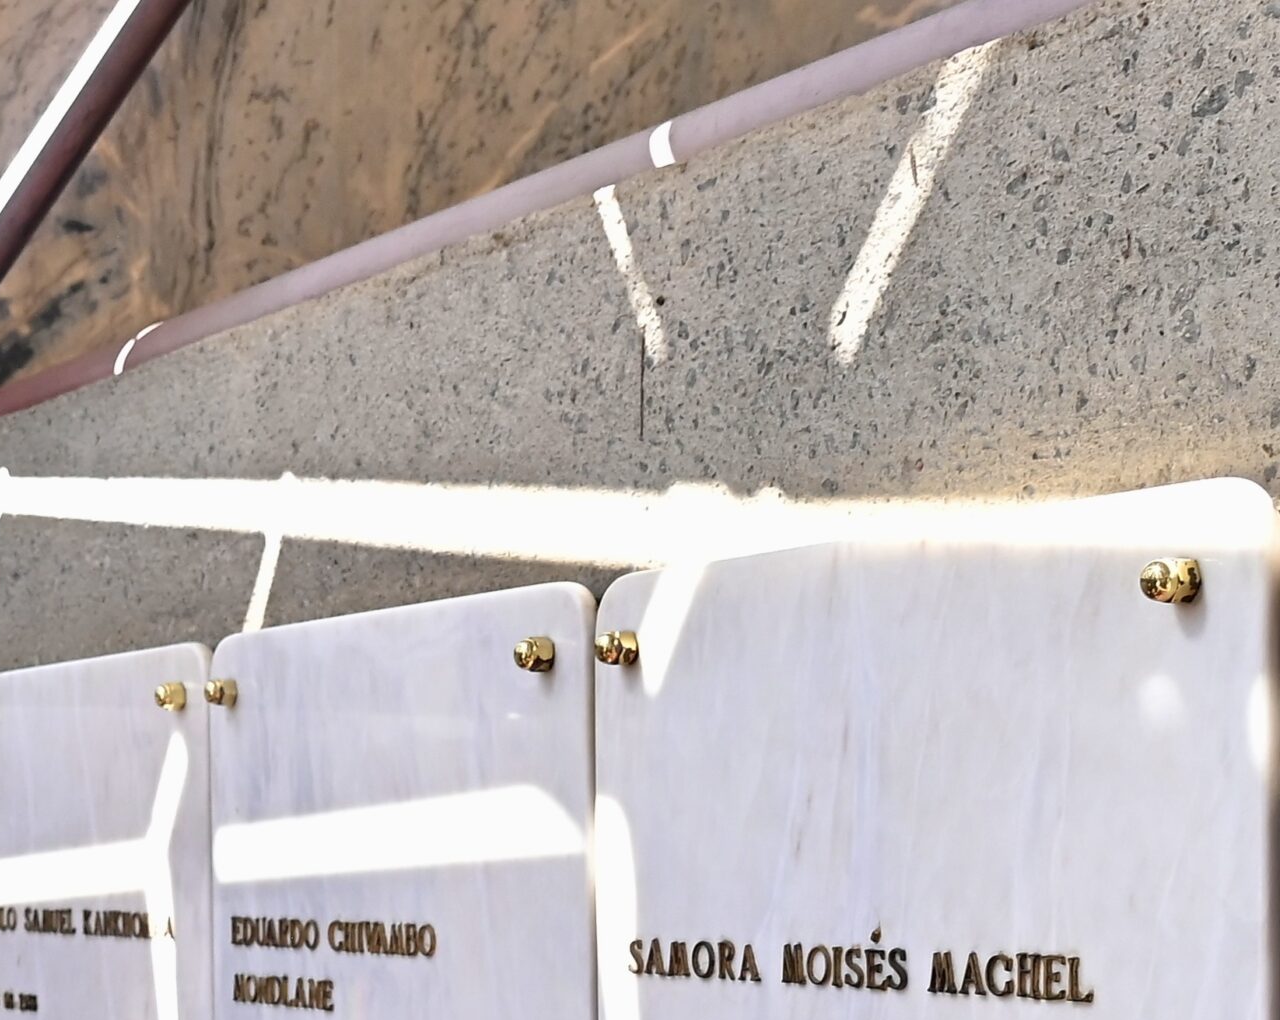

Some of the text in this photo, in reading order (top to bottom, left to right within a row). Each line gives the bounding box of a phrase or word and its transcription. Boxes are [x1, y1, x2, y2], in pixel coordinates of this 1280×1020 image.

[231, 916, 437, 957] EDUARDO CHIVAMBO
[628, 922, 1094, 1003] SAMORA MOISÉS MACHEL
